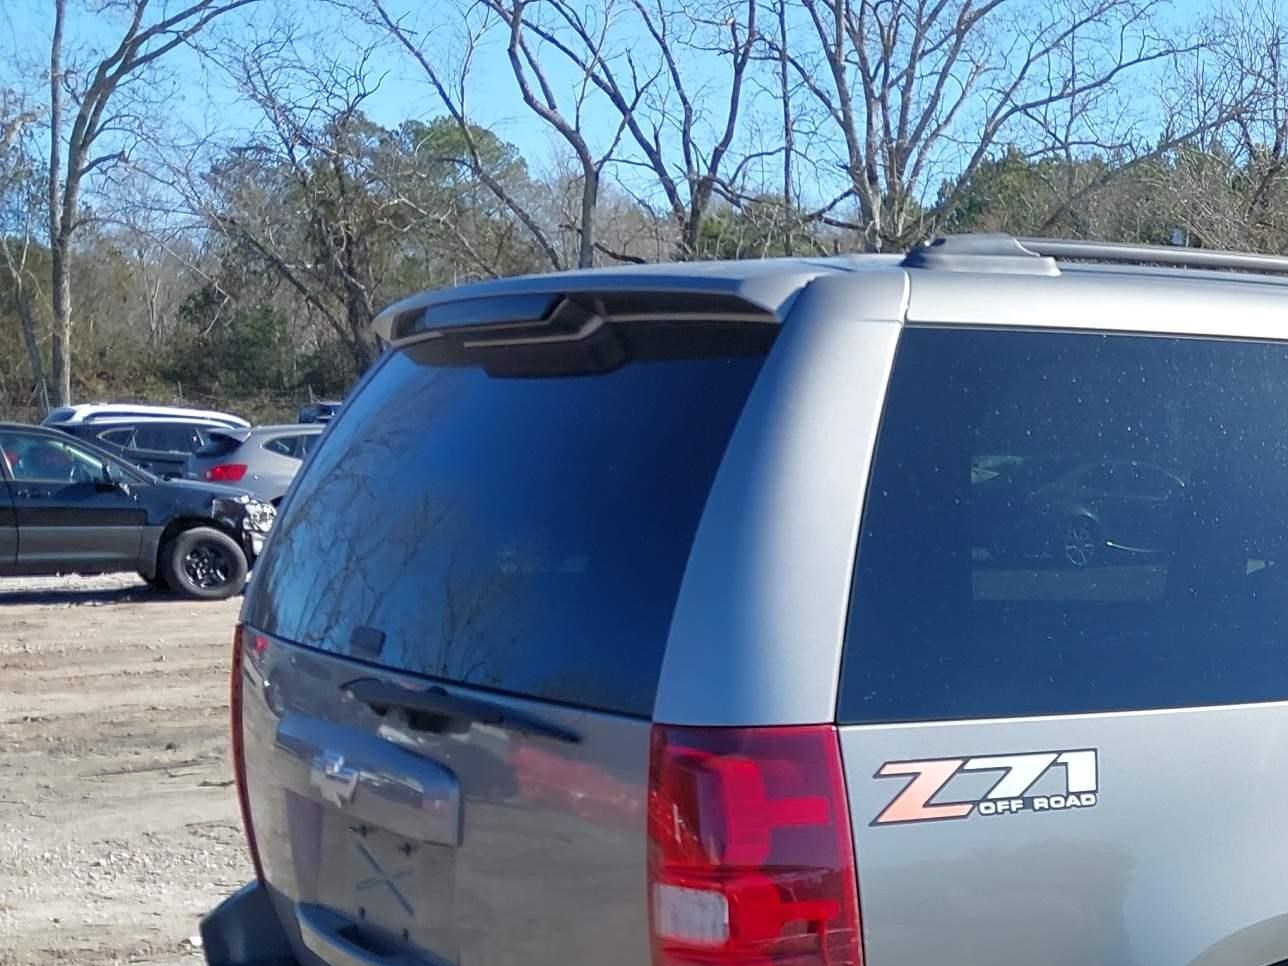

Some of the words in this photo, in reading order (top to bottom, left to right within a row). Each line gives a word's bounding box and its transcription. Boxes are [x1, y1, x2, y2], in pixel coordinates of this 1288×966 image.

[868, 747, 1098, 827] Z71
[978, 799, 1024, 816] OFF
[1032, 792, 1098, 812] ROAD
